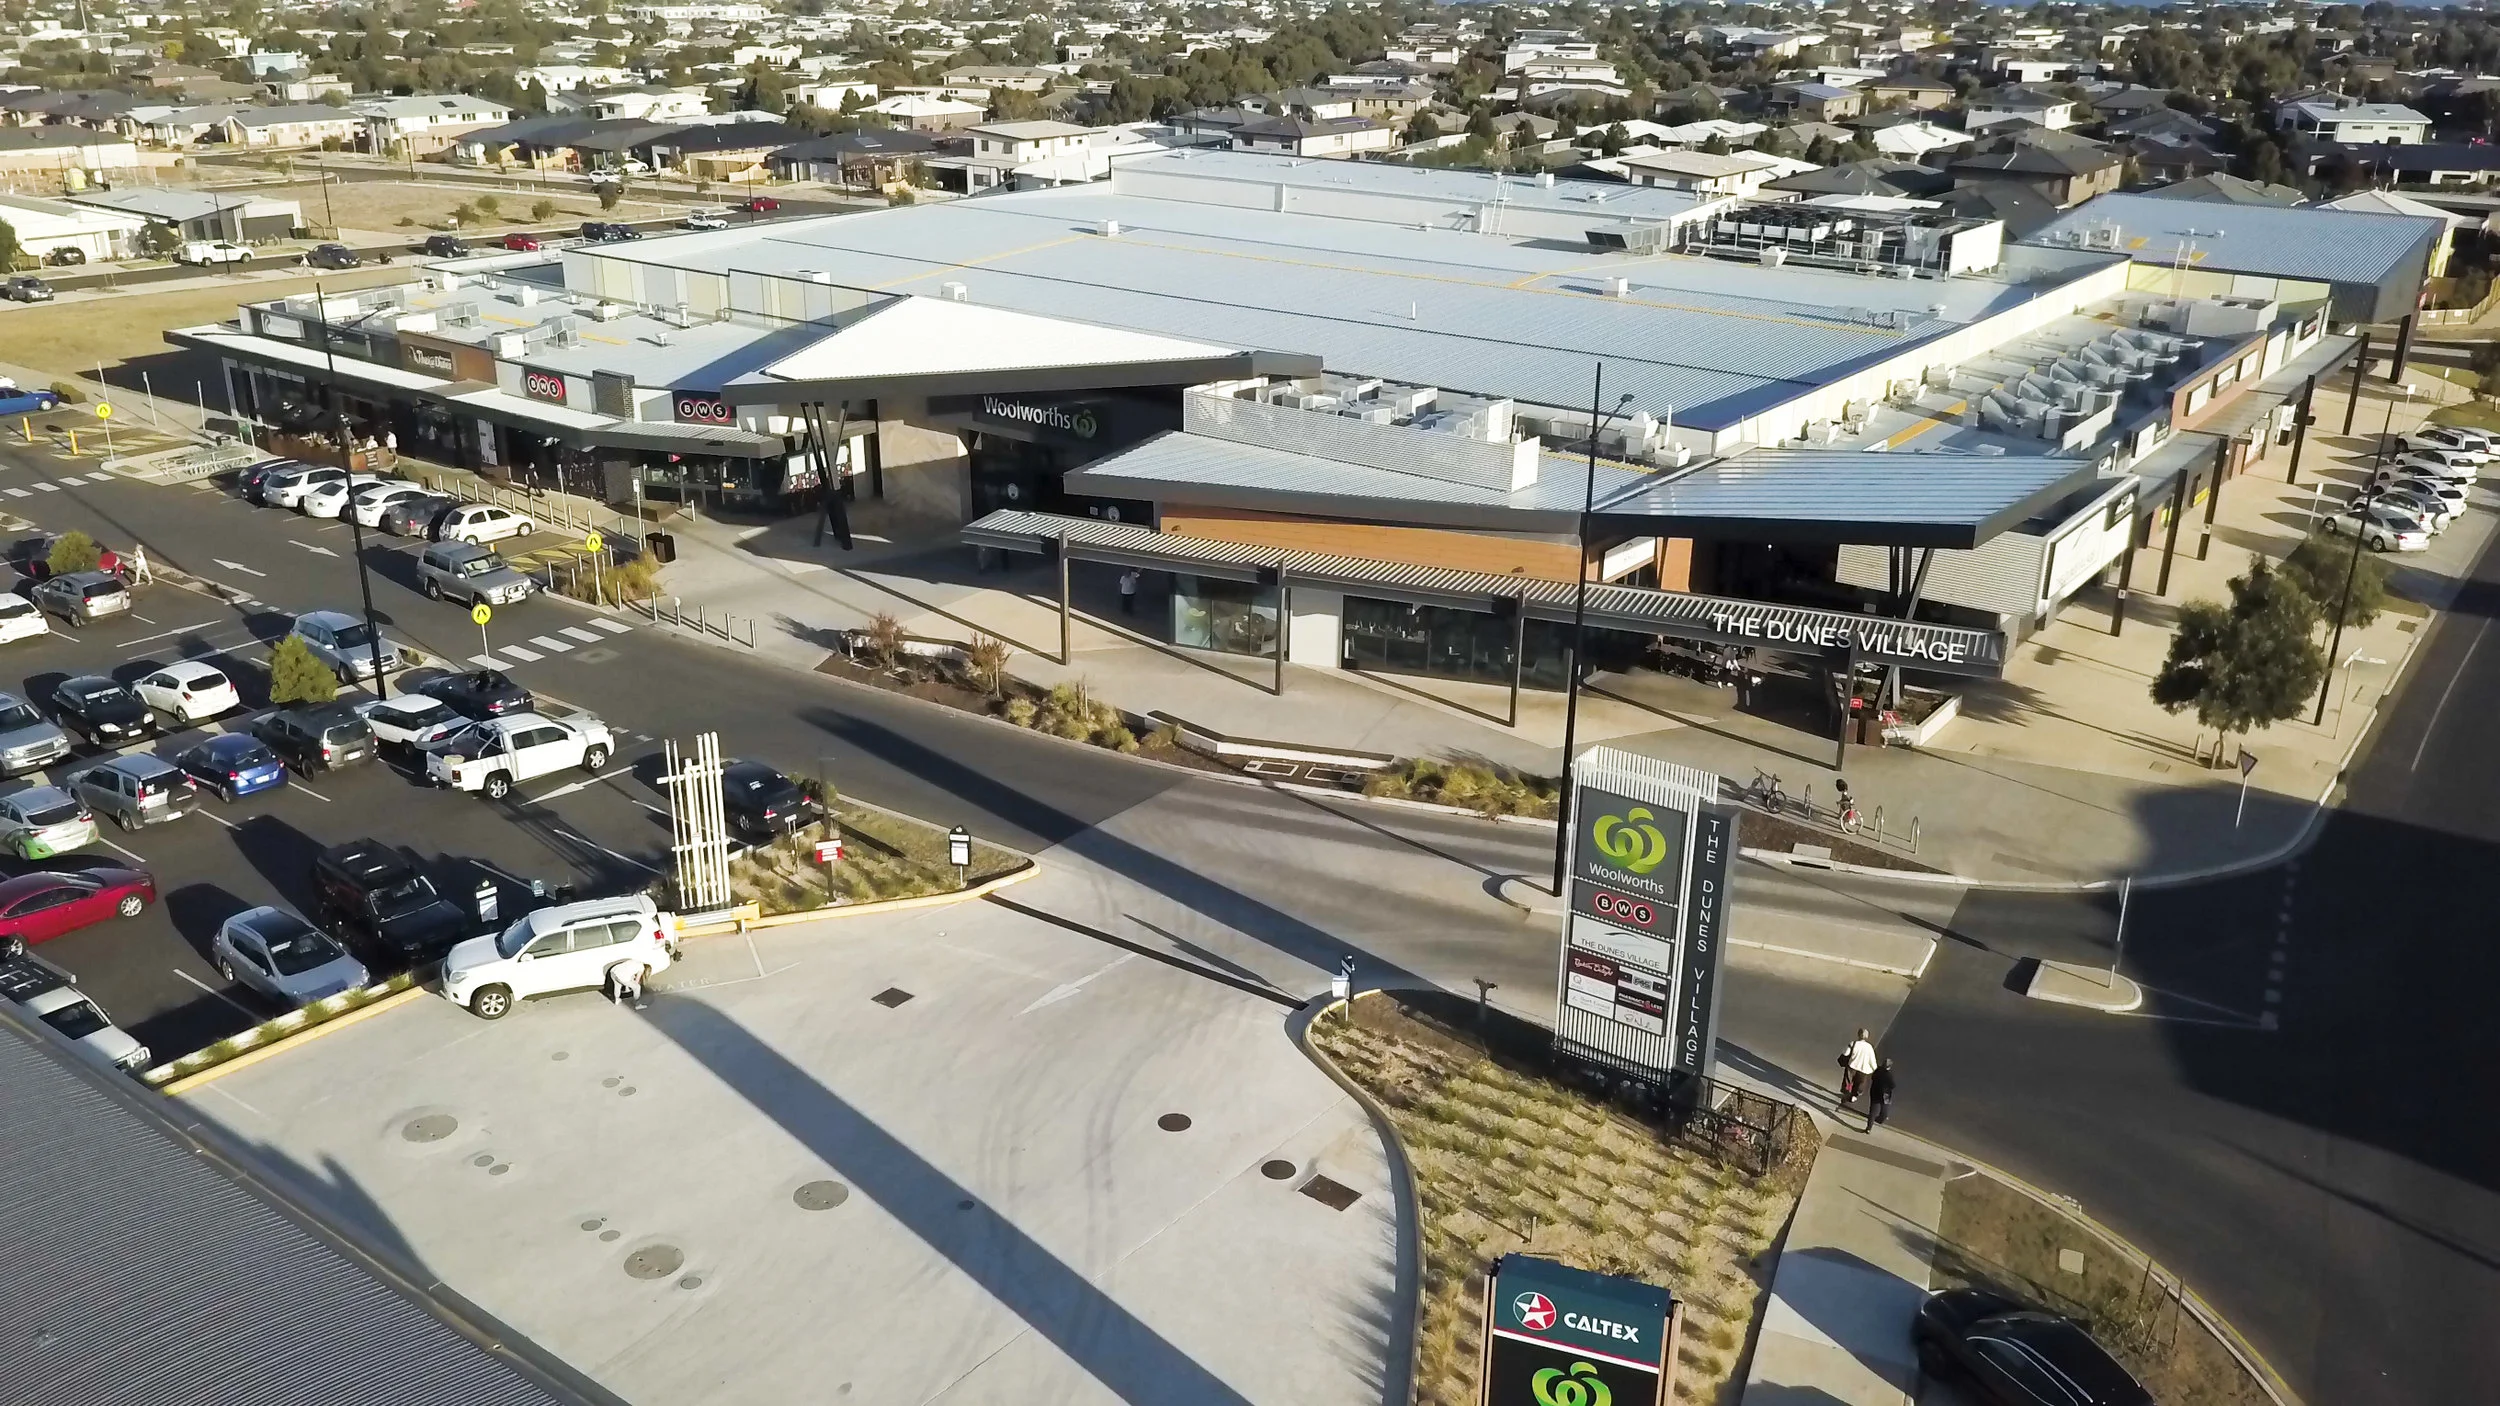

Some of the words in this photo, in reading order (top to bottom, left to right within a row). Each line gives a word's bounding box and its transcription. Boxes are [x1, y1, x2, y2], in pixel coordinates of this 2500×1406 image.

[529, 377, 559, 396] BWS
[681, 402, 725, 417] BWS
[983, 395, 1071, 429] Woolworths
[1713, 612, 1760, 638] THE
[1767, 620, 1851, 649] DUNES
[1859, 631, 1967, 664] VILLAGE
[1706, 819, 1720, 864] THE
[1589, 862, 1664, 895] Woolworths
[1598, 896, 1649, 921] BWS
[1697, 879, 1714, 953] DUNES
[1581, 938, 1597, 949] THE
[1597, 943, 1626, 958] DUNES
[1627, 952, 1660, 969] VILLAGE
[651, 978, 711, 992] WATER
[1685, 967, 1705, 1066] VILLAGE
[1563, 1312, 1640, 1343] CALTEX
